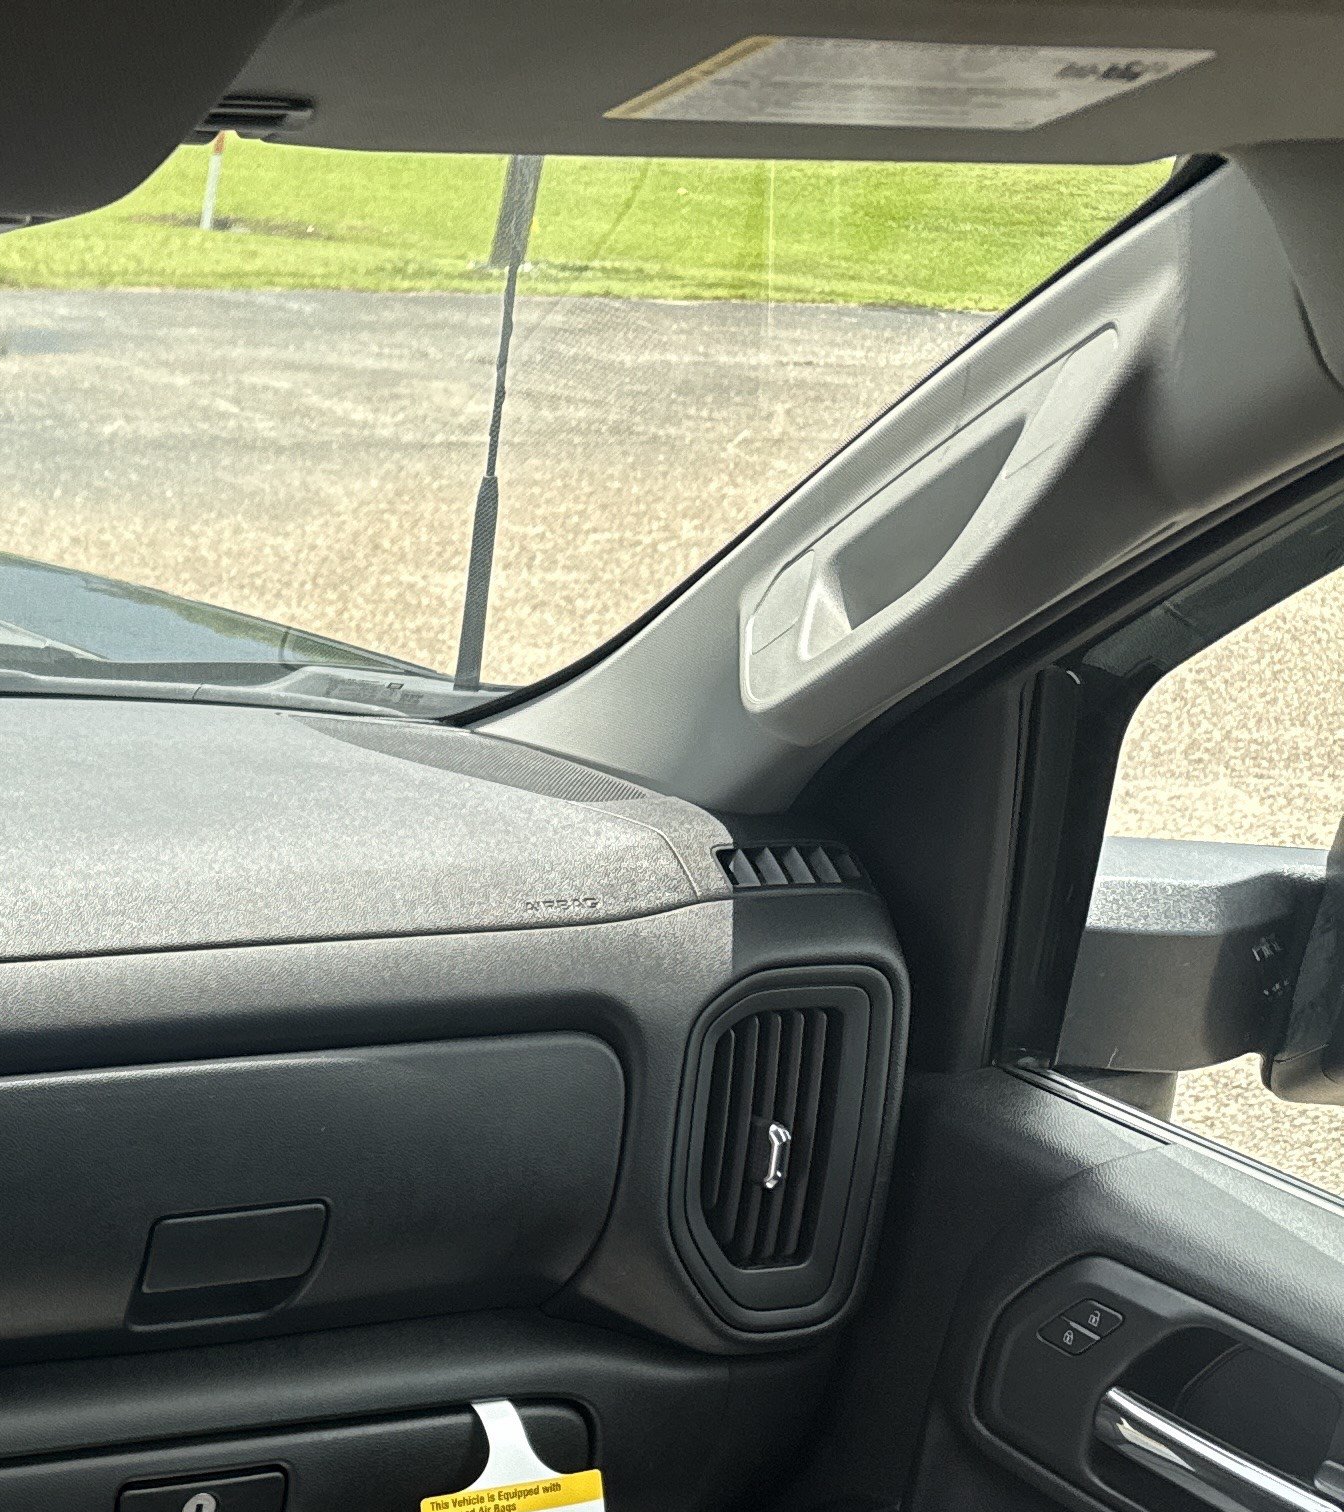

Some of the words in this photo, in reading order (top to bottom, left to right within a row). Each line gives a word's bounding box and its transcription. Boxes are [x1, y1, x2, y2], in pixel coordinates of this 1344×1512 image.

[430, 1501, 450, 1512] This
[451, 1494, 485, 1509] Vehicle
[487, 1493, 496, 1502] is
[498, 1485, 540, 1502] Equipped
[542, 1482, 562, 1493] with
